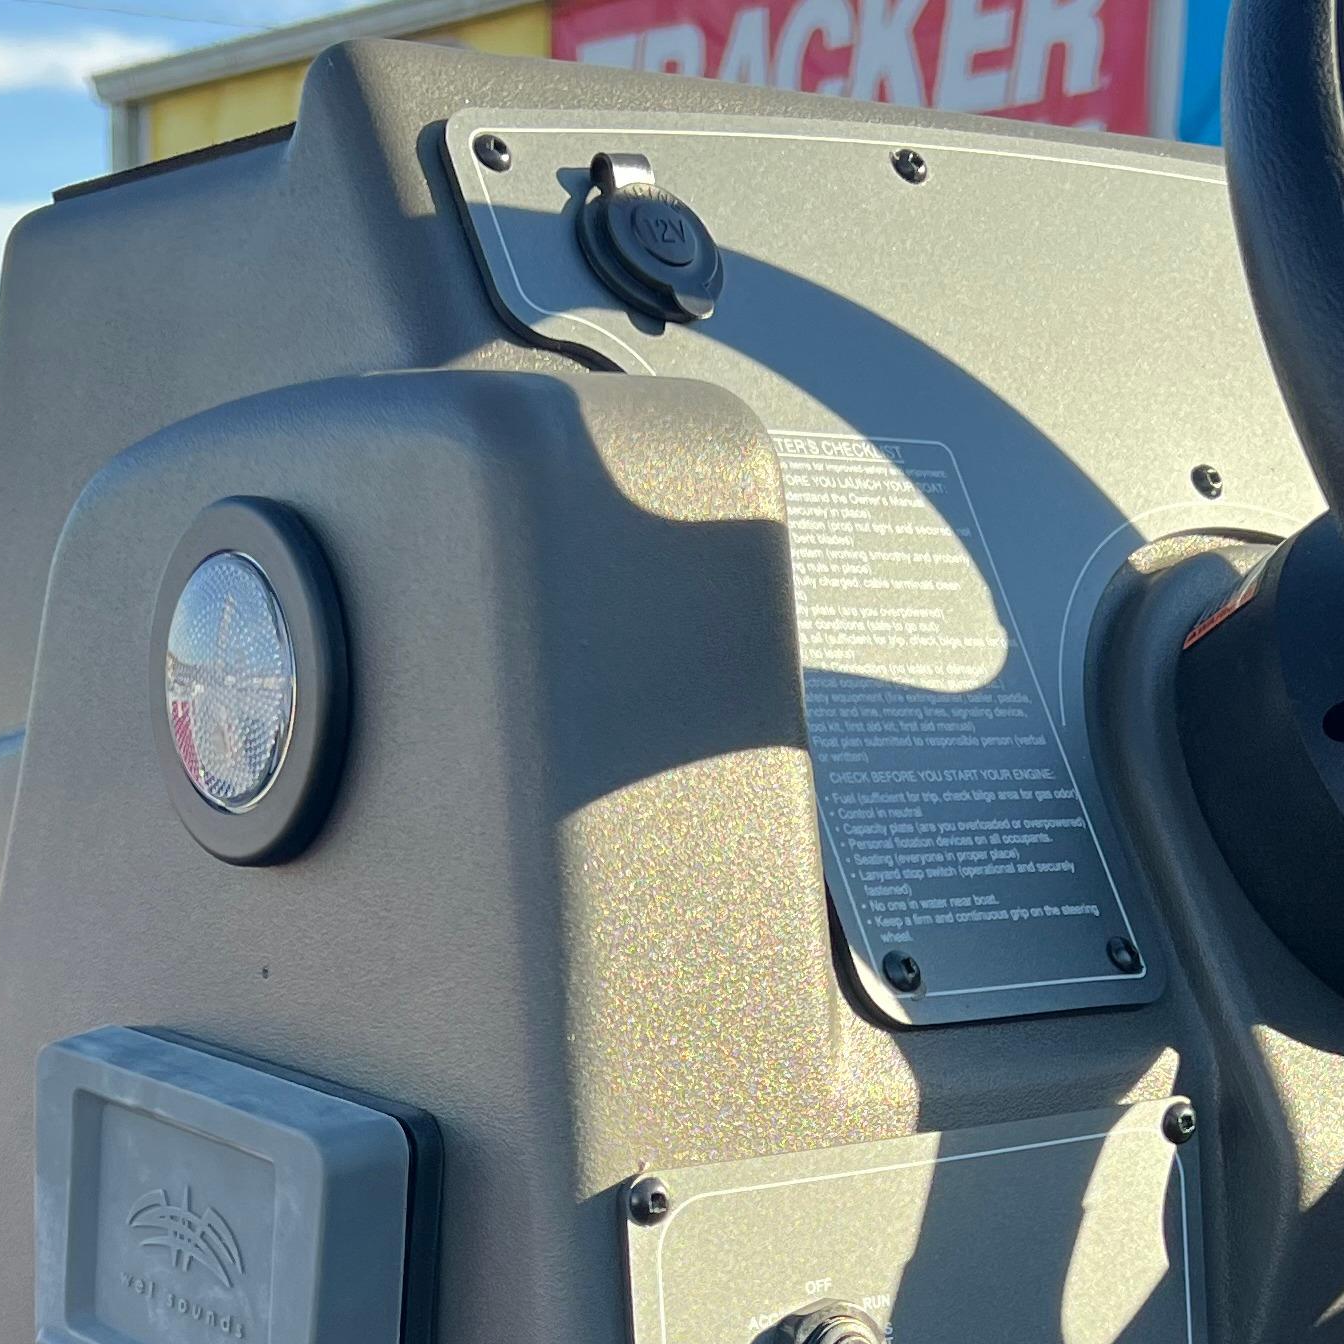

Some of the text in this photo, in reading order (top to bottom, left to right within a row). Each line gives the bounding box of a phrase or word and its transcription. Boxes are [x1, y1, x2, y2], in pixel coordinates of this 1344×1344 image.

[574, 0, 1108, 109] RACKER
[644, 218, 687, 243] 12V
[822, 440, 903, 459] CHECKLIST
[813, 475, 837, 489] YOU
[838, 477, 881, 490] LAUNCH
[884, 480, 914, 493] YOUR
[830, 768, 1055, 784] CHECK BEFORE YOU START YOUR ENGINE:
[832, 793, 856, 804] Fuel
[838, 807, 923, 820] Control in neutral
[843, 824, 887, 837] Capacity
[938, 823, 955, 834] you
[848, 838, 893, 850] Personal
[854, 855, 894, 867] Seating
[858, 870, 901, 883] Lanyard
[869, 901, 886, 911] No
[874, 917, 904, 929] Keep
[935, 912, 953, 923] and
[805, 1277, 832, 1296] OFF
[863, 1295, 891, 1311] RUN
[167, 1293, 245, 1339] sounds
